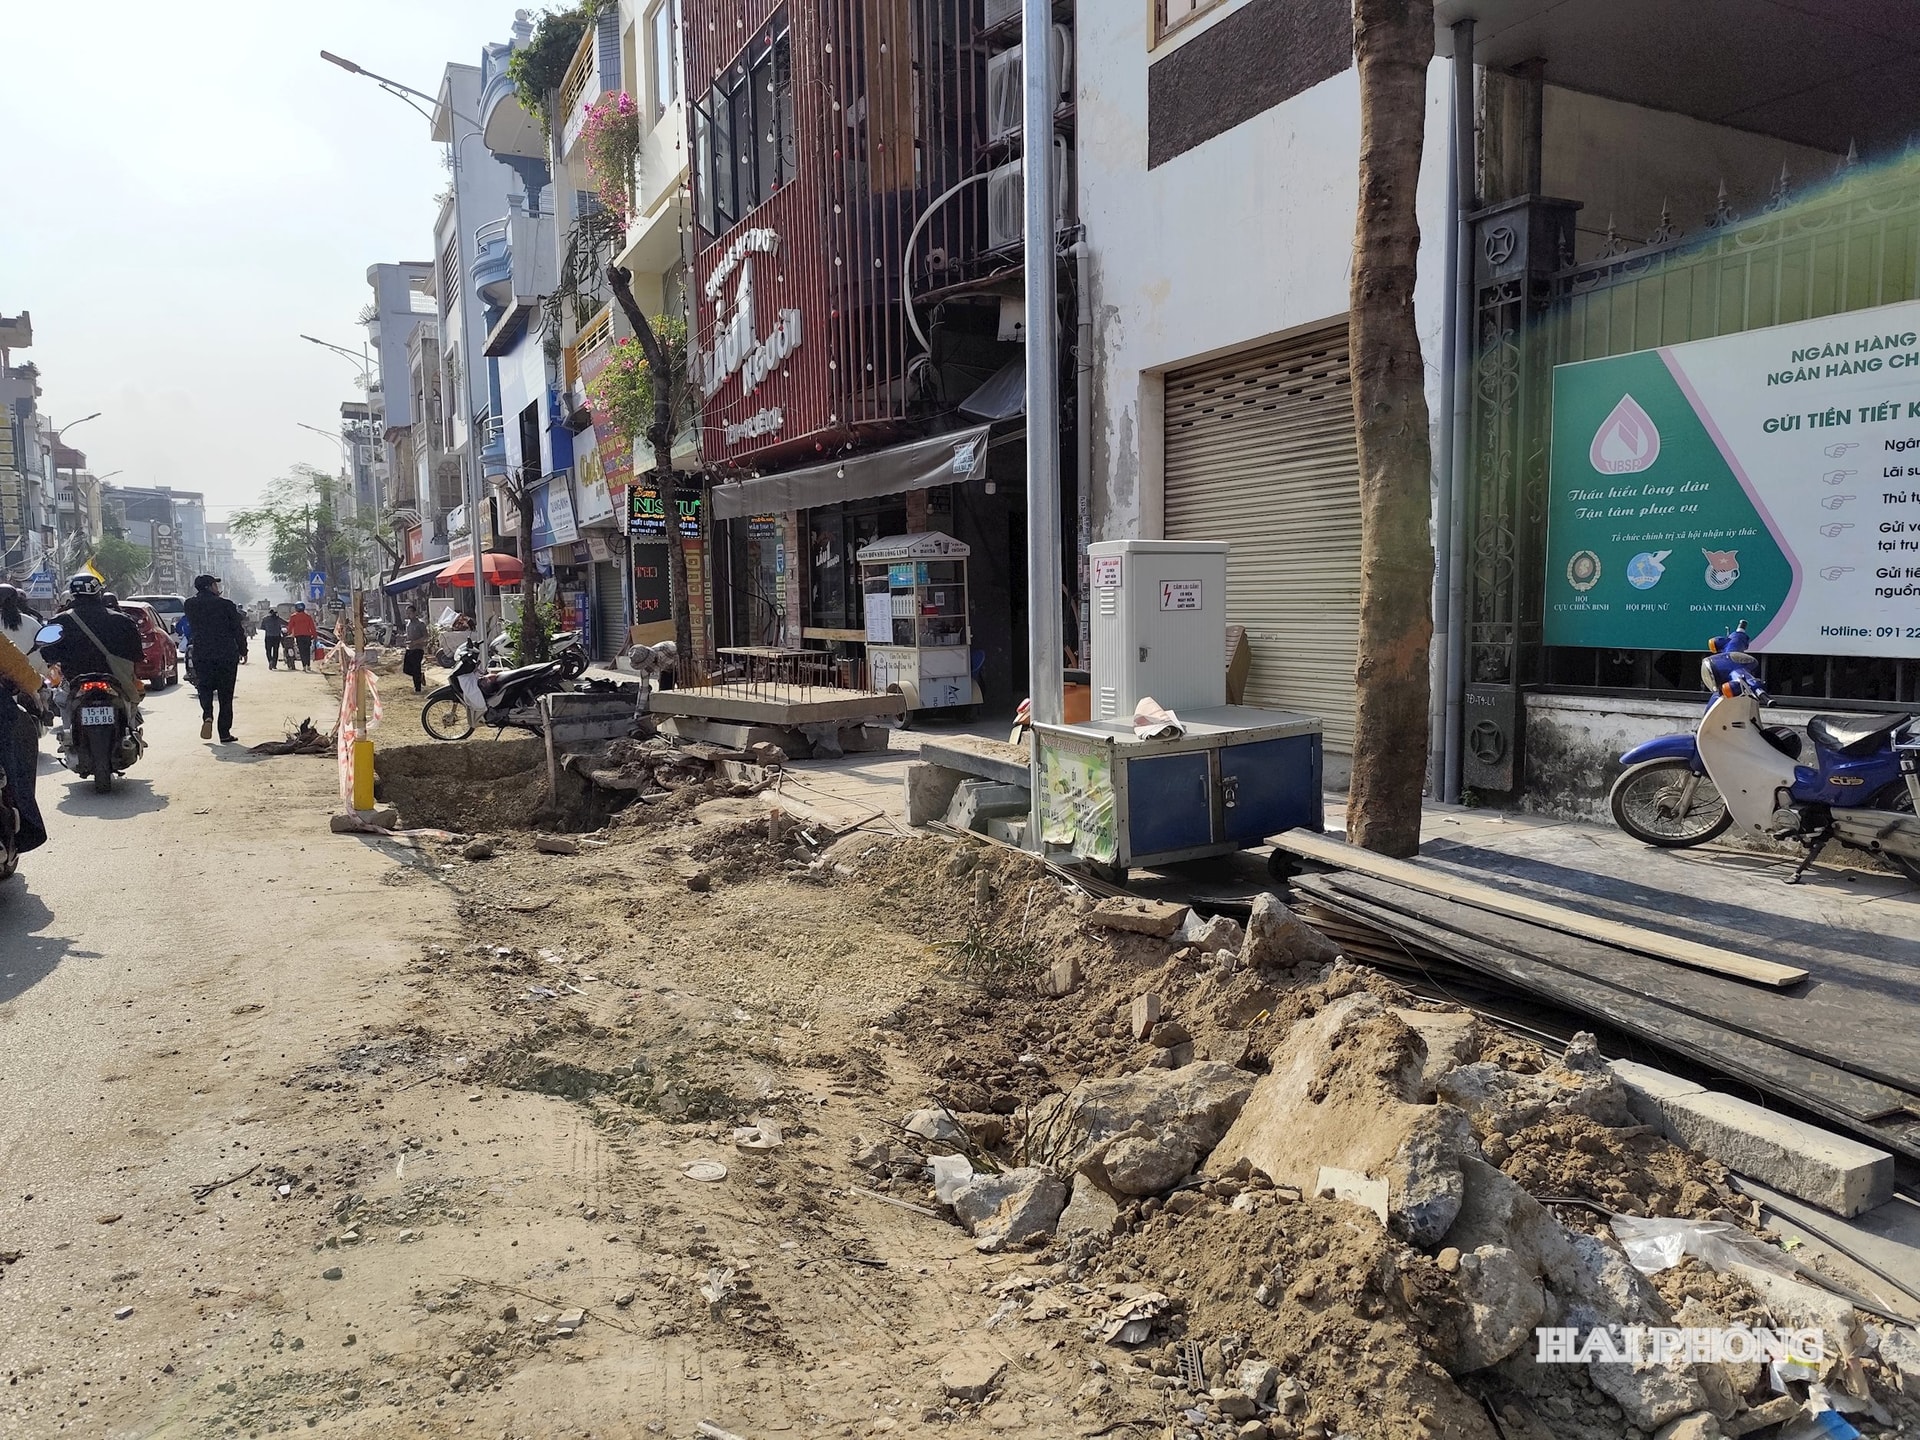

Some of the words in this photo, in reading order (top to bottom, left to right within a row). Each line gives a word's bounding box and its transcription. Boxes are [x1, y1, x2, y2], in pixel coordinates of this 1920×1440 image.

[1792, 342, 1848, 362] NGÂN
[1854, 332, 1917, 354] HÀNG
[1767, 366, 1820, 386] NGÂN
[1826, 358, 1882, 378] HÀNG
[1888, 352, 1919, 368] CH
[1762, 414, 1800, 434] GỬI
[1808, 407, 1852, 428] TIỀN
[1858, 400, 1901, 423] TIẾT
[1884, 466, 1903, 477] Lãi
[1567, 488, 1604, 501] Thấu
[1608, 485, 1638, 498] hiểu
[1642, 484, 1674, 497] lòng
[1680, 480, 1710, 493] dân
[1882, 491, 1906, 504] Thủ
[1574, 508, 1604, 520] Tận
[1608, 505, 1634, 517] tâm
[1640, 503, 1675, 518] phục
[1680, 504, 1700, 515] vụ
[1738, 527, 1758, 536] thác
[1879, 520, 1904, 533] Gửi
[1909, 524, 1920, 532] v
[1878, 540, 1896, 552] tại
[1900, 540, 1918, 552] trụ
[1876, 566, 1901, 578] Gửi
[1875, 583, 1920, 598] nguồn
[1570, 602, 1592, 610] CHIẾN
[1626, 603, 1640, 612] HỘI
[1641, 603, 1655, 612] PHỤ
[1690, 602, 1714, 612] ĐOÀN
[1746, 603, 1766, 612] NIÊN
[1820, 626, 1872, 636] Hotline:
[1876, 627, 1900, 637] 091
